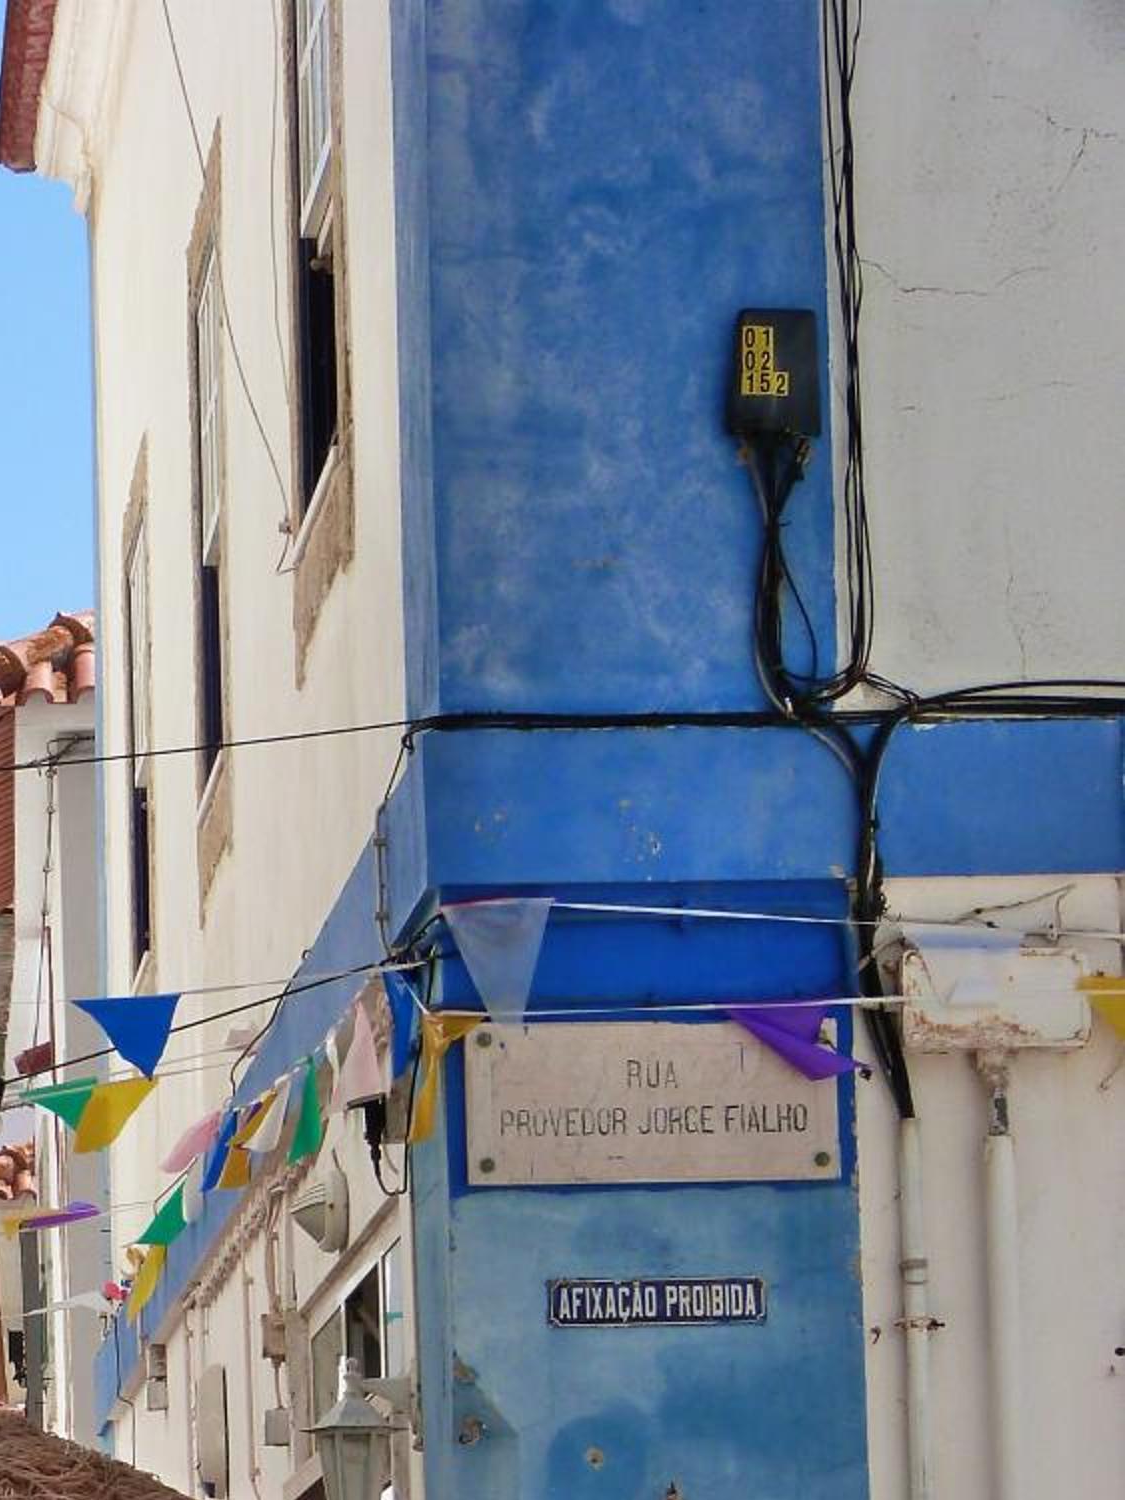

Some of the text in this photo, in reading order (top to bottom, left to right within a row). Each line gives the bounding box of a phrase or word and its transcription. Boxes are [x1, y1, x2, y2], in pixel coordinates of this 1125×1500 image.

[744, 327, 771, 348] 01
[744, 350, 771, 371] 02
[746, 372, 786, 394] 152
[626, 1059, 679, 1090] RUA
[499, 1103, 808, 1138] PROVEDOR JORGE FIALHO
[558, 1280, 757, 1323] AFIXAÇÃO PROIBIDA
